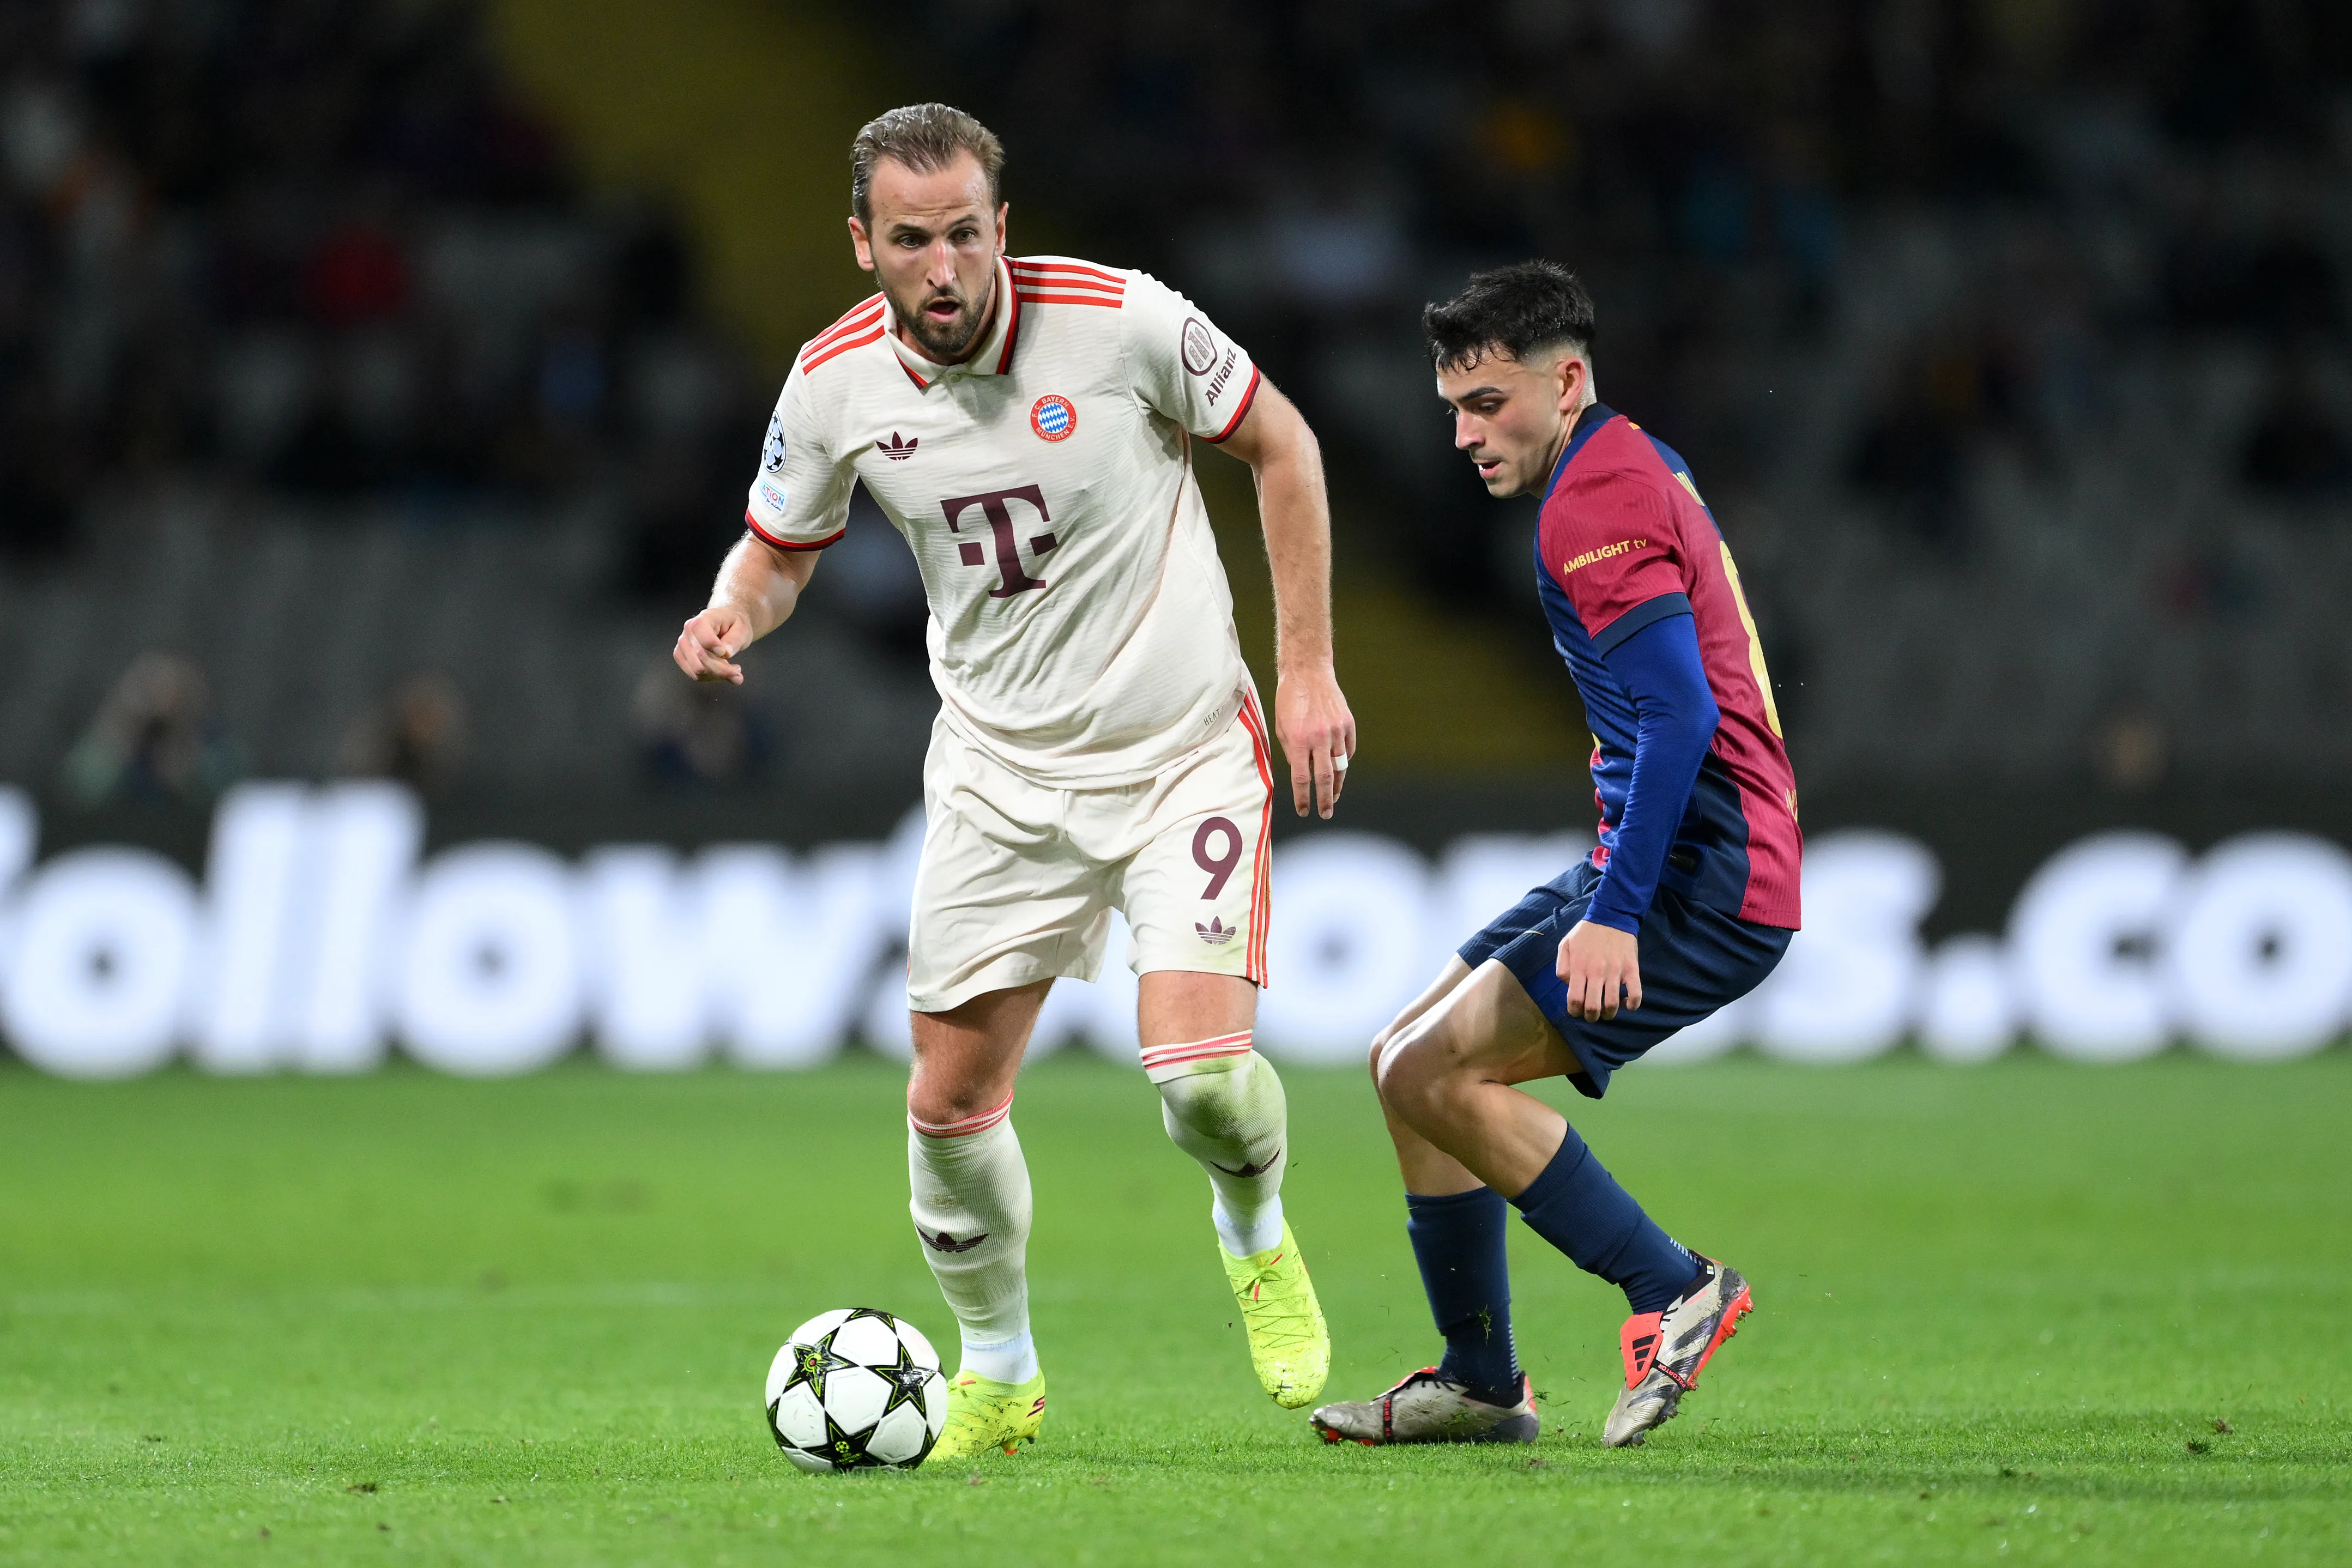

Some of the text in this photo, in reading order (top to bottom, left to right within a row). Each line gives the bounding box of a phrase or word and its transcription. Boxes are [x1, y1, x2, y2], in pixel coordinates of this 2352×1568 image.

[1205, 347, 1236, 407] Allianz
[1041, 396, 1069, 408] BAYERN
[1563, 538, 1647, 576] AMBILIGHT tv
[1192, 816, 1243, 900] 9
[1658, 1363, 1687, 1388] PREDATOR
